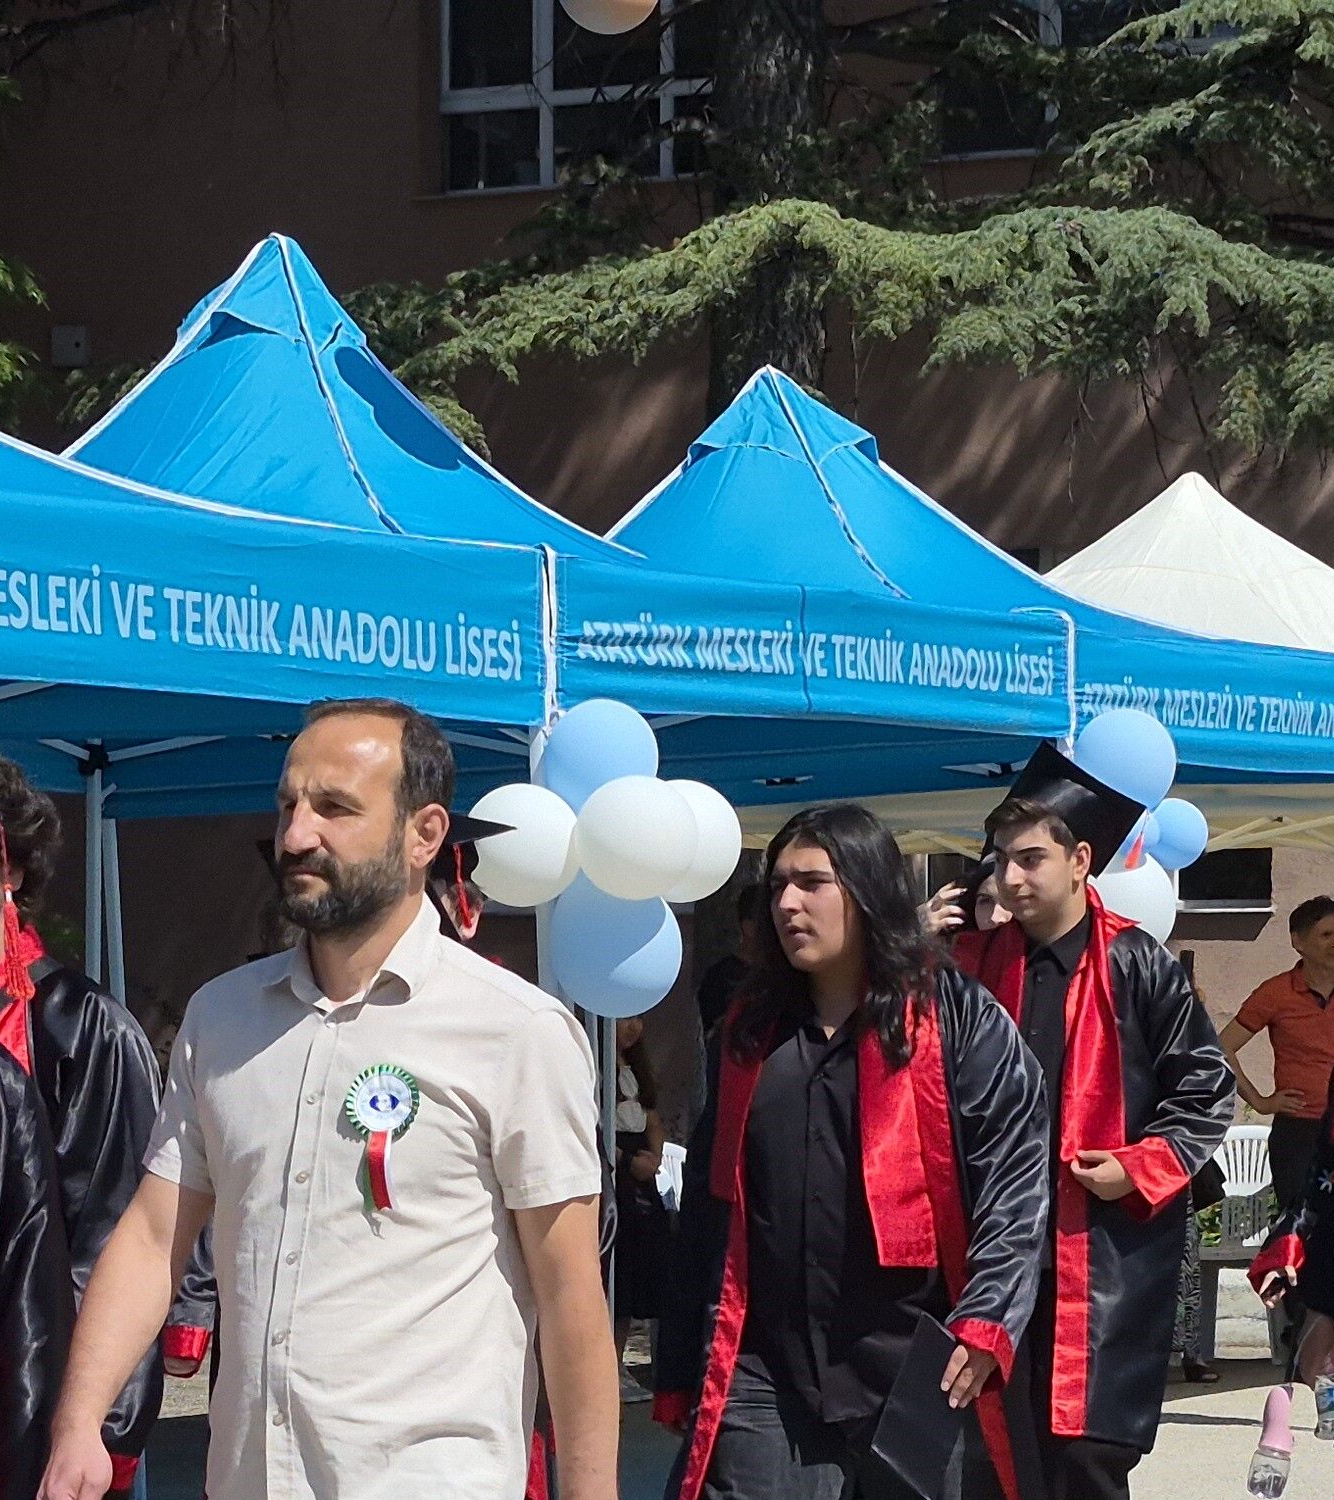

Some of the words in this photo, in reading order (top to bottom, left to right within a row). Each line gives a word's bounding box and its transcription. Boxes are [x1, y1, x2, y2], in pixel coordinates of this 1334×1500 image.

[111, 583, 156, 642] VE
[163, 584, 283, 655] TEKNİK
[289, 609, 437, 674] ANADOLU
[444, 612, 522, 682] LİSESİ
[695, 620, 795, 676] MESLEKİ
[799, 631, 828, 677] VE
[831, 628, 905, 684] TEKNİK
[908, 642, 1003, 692] ANADOLU
[1005, 642, 1054, 697] LİSESİ
[1162, 684, 1233, 730] MESLEKİ
[1234, 694, 1258, 732] VE
[1258, 691, 1315, 737] TEKNİK
